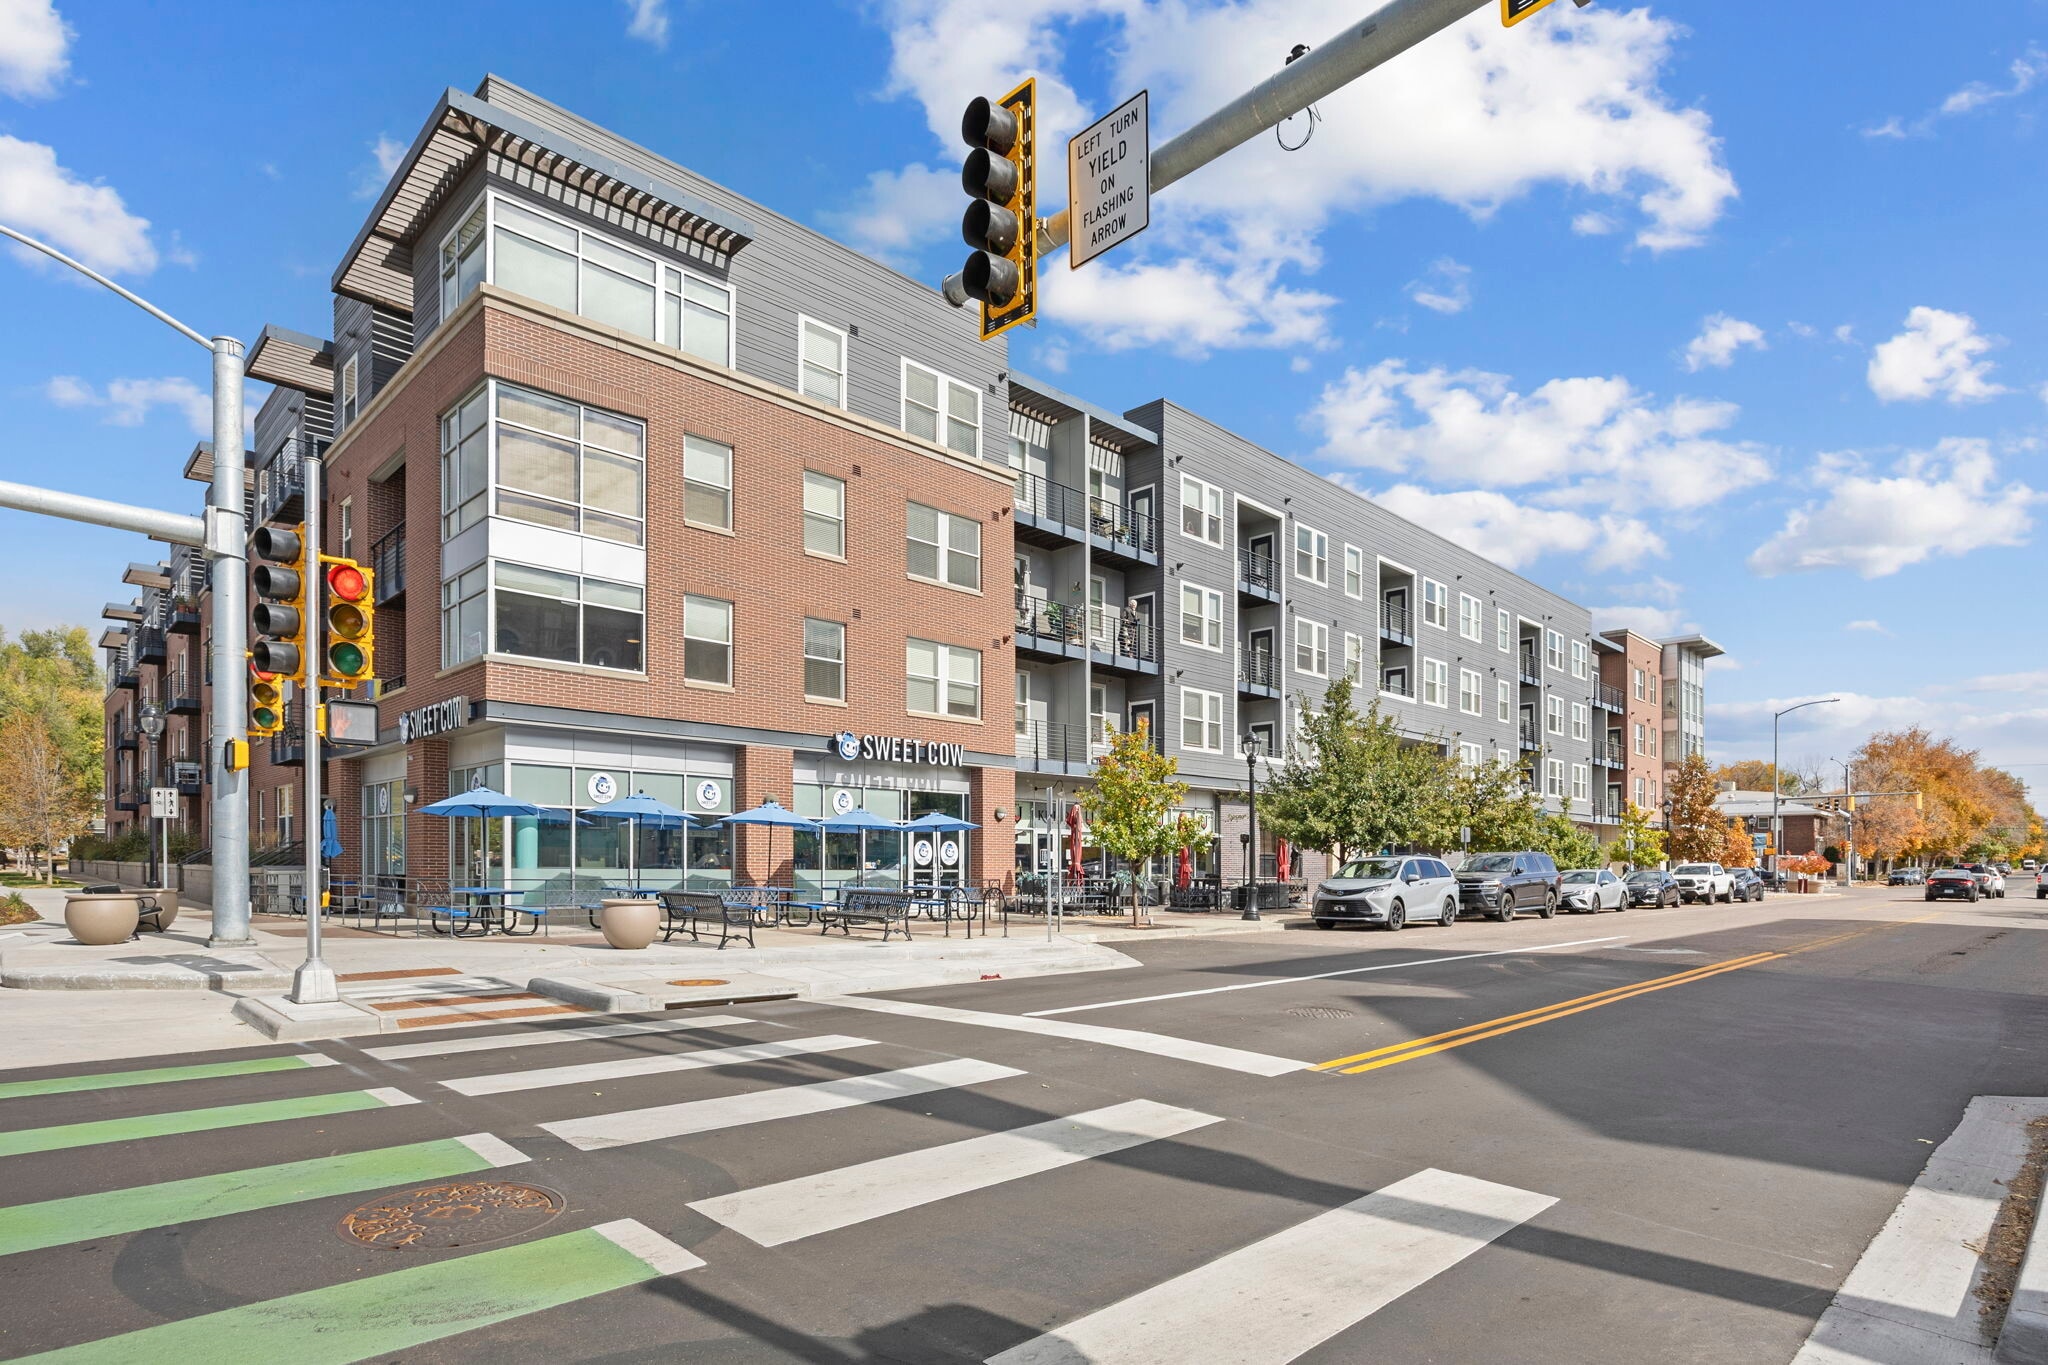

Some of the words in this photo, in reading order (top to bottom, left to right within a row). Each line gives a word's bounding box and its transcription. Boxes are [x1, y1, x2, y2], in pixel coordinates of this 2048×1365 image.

[1077, 131, 1101, 160] LEFT
[1110, 107, 1138, 138] TURN
[1089, 140, 1127, 178] YIELD
[1100, 173, 1115, 194] ON
[1083, 186, 1134, 229] FLASHING
[1090, 213, 1127, 247] ARROW
[410, 703, 440, 739] SWEET
[441, 695, 462, 732] COW
[863, 734, 922, 764] SWEET
[928, 741, 965, 767] COW
